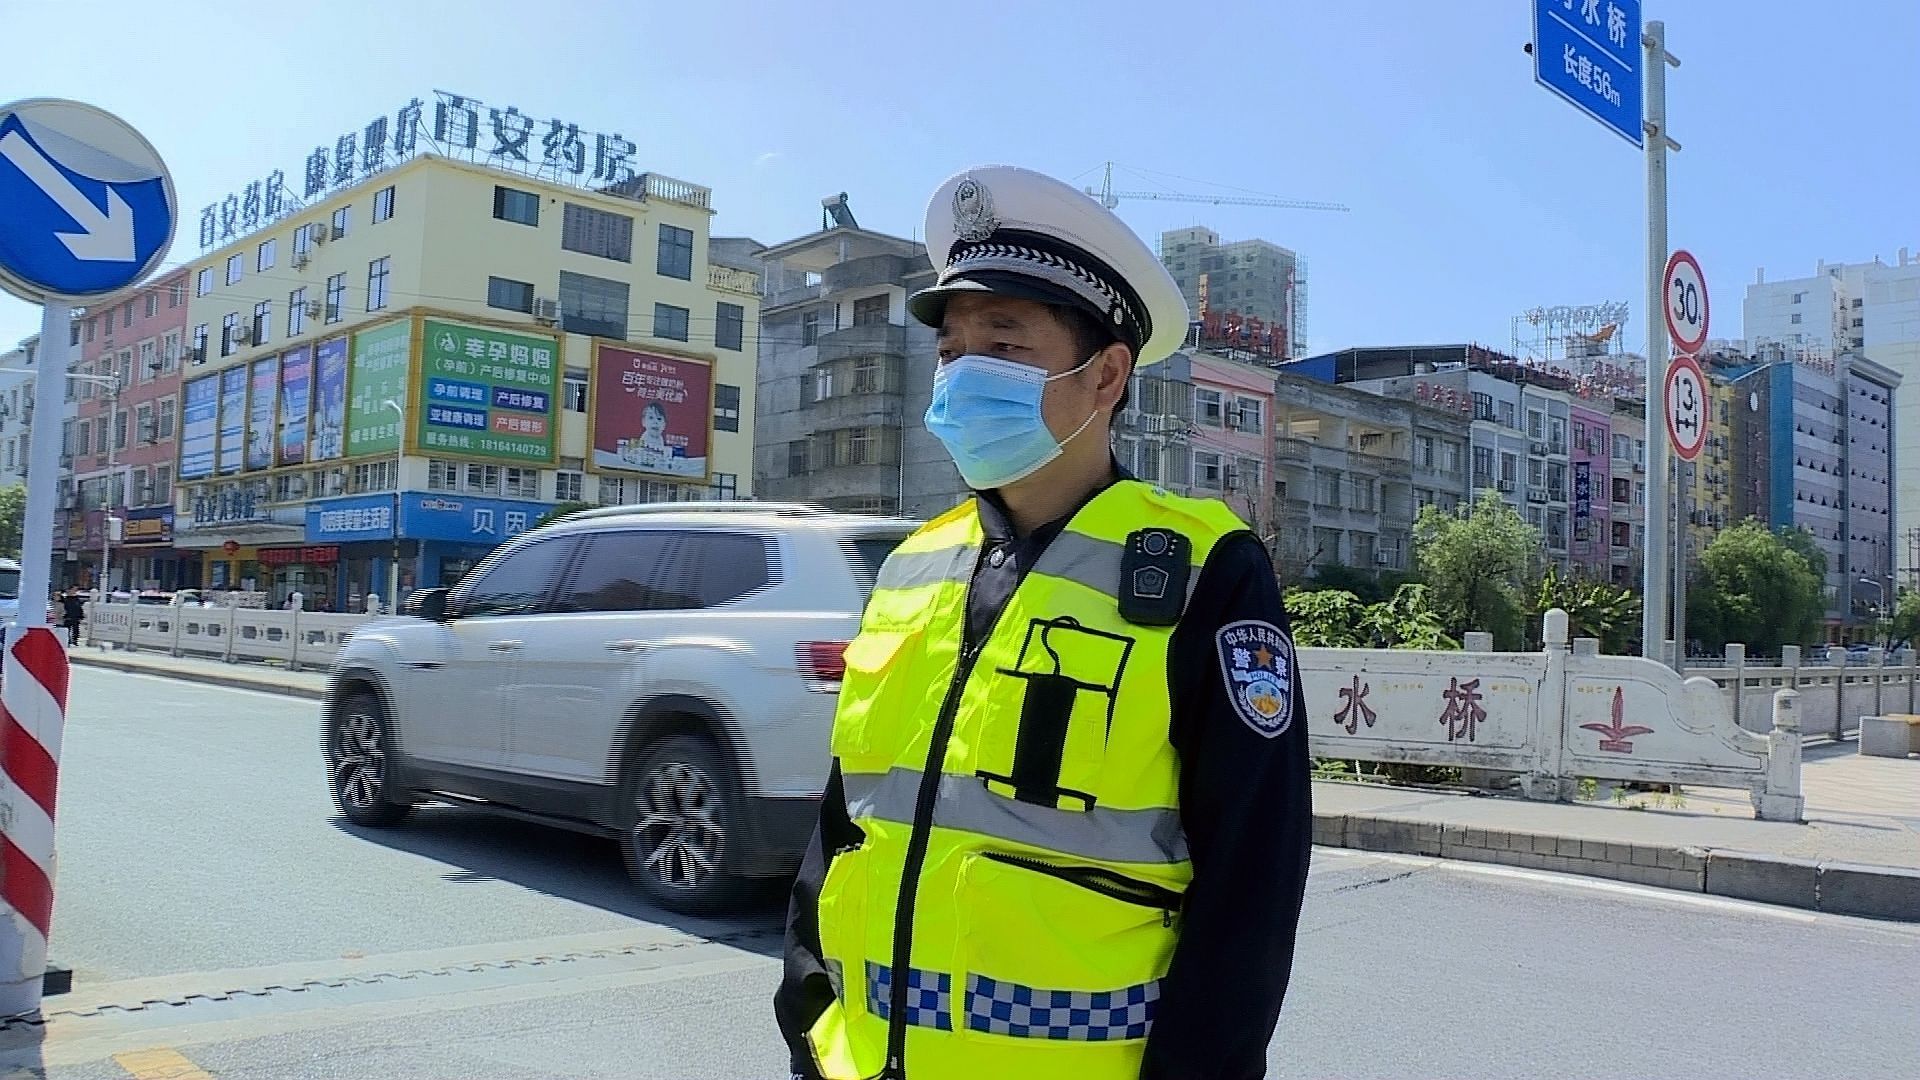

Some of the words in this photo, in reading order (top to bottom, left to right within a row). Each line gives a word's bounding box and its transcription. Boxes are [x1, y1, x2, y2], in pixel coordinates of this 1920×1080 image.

[1563, 0, 1627, 48] 水桥
[1564, 44, 1621, 107] 长度56m
[433, 91, 637, 183] 百安药房
[199, 168, 284, 248] 百安药房
[464, 337, 551, 369] 幸孕妈妈
[433, 383, 484, 401] 孕前调理
[496, 391, 545, 409] 产后修复
[430, 408, 484, 427] 亚健康调理
[480, 438, 547, 456] 18164140729
[472, 508, 545, 535] 贝因
